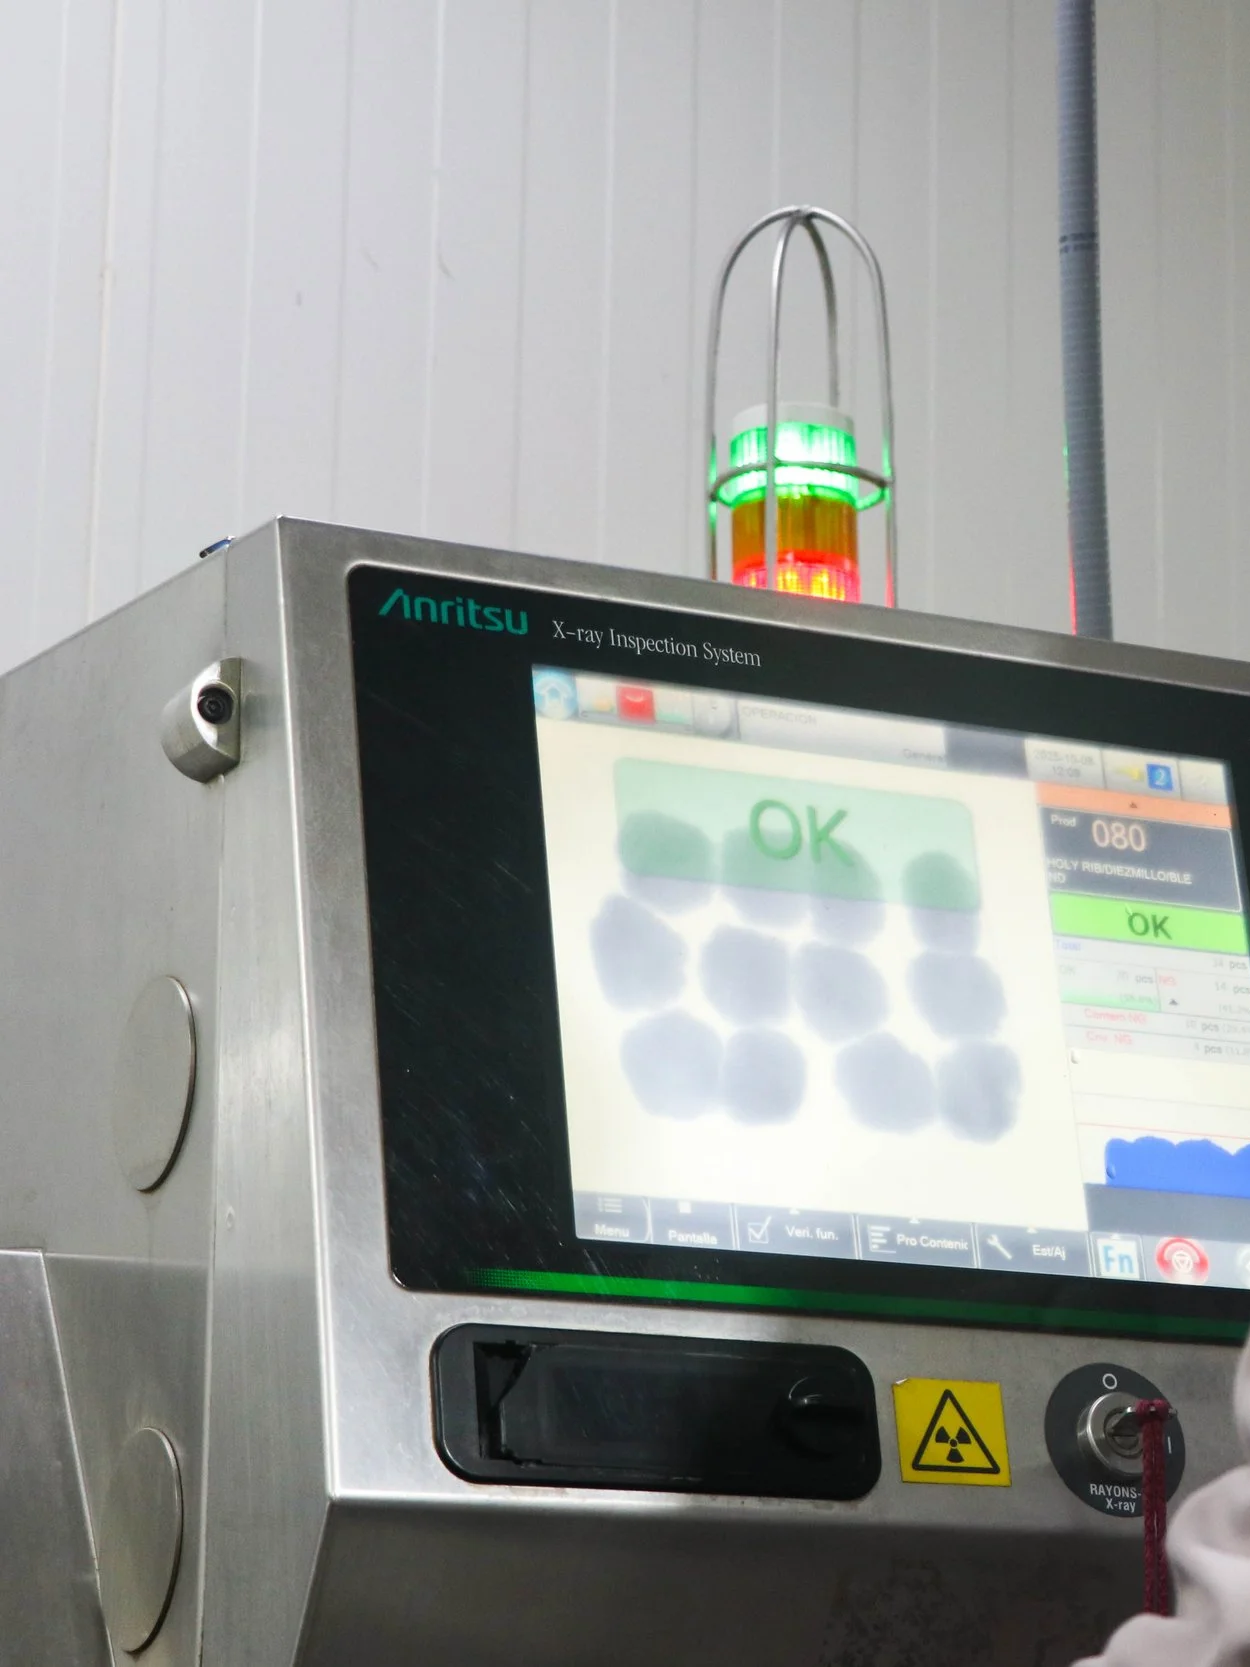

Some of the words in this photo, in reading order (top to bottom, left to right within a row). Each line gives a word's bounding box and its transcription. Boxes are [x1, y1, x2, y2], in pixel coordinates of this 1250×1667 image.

[378, 588, 529, 636] Anritsu
[551, 619, 604, 648] X-ray
[609, 628, 699, 659] Inspection
[702, 642, 762, 668] System
[749, 799, 855, 868] OK
[1050, 814, 1077, 828] Prod
[1091, 819, 1147, 852] 080
[1127, 911, 1173, 942] OK
[1228, 960, 1248, 971] pcs
[1135, 975, 1154, 986] pcs
[1232, 985, 1250, 996] pcs
[1201, 1022, 1220, 1034] pcs
[1204, 1044, 1223, 1056] pcs
[595, 1222, 630, 1239] Menu
[785, 1224, 812, 1239] Veri.
[815, 1226, 839, 1241] fun.
[896, 1234, 917, 1248] Pro
[1103, 1245, 1134, 1274] Fn
[1106, 1497, 1136, 1513] X-ray
